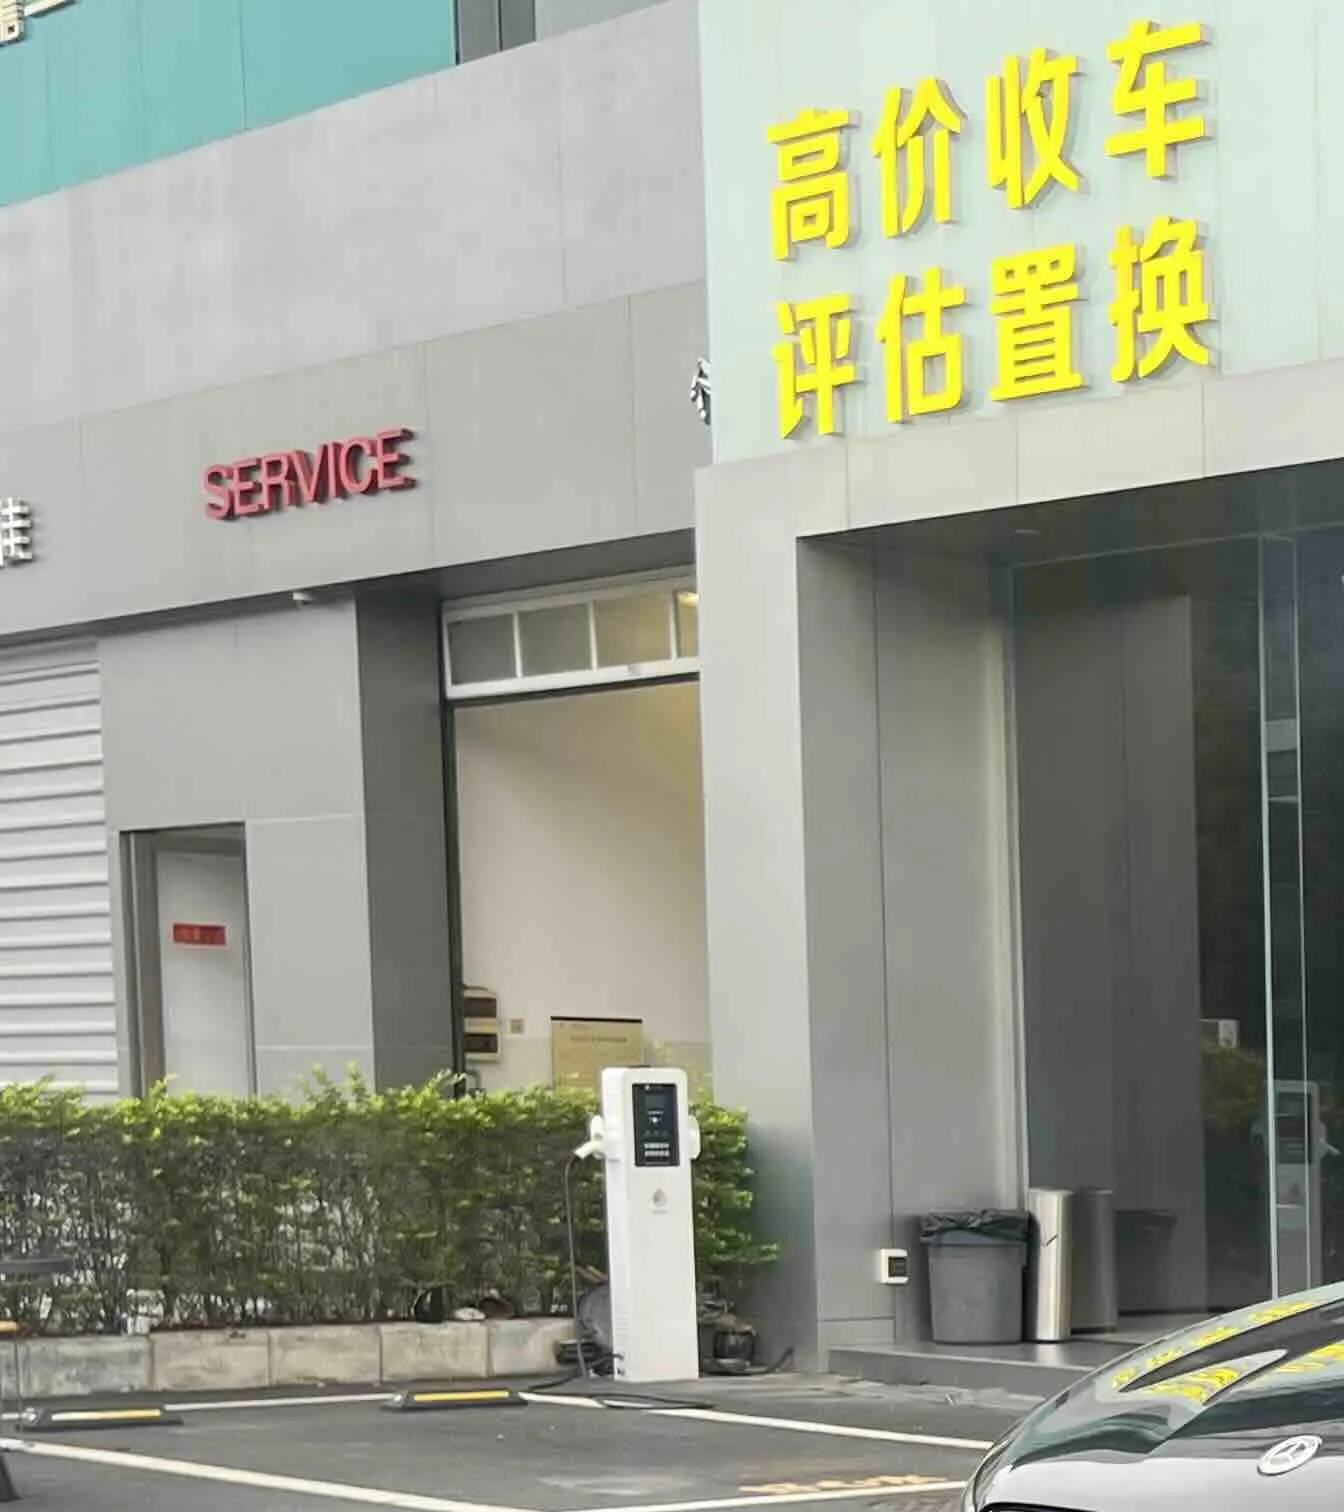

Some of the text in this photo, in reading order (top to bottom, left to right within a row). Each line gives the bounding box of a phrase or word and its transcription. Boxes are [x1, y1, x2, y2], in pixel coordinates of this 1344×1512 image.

[766, 18, 1208, 261] 高价收车
[772, 214, 1212, 440] 评估置换
[203, 425, 414, 520] SERVICE
